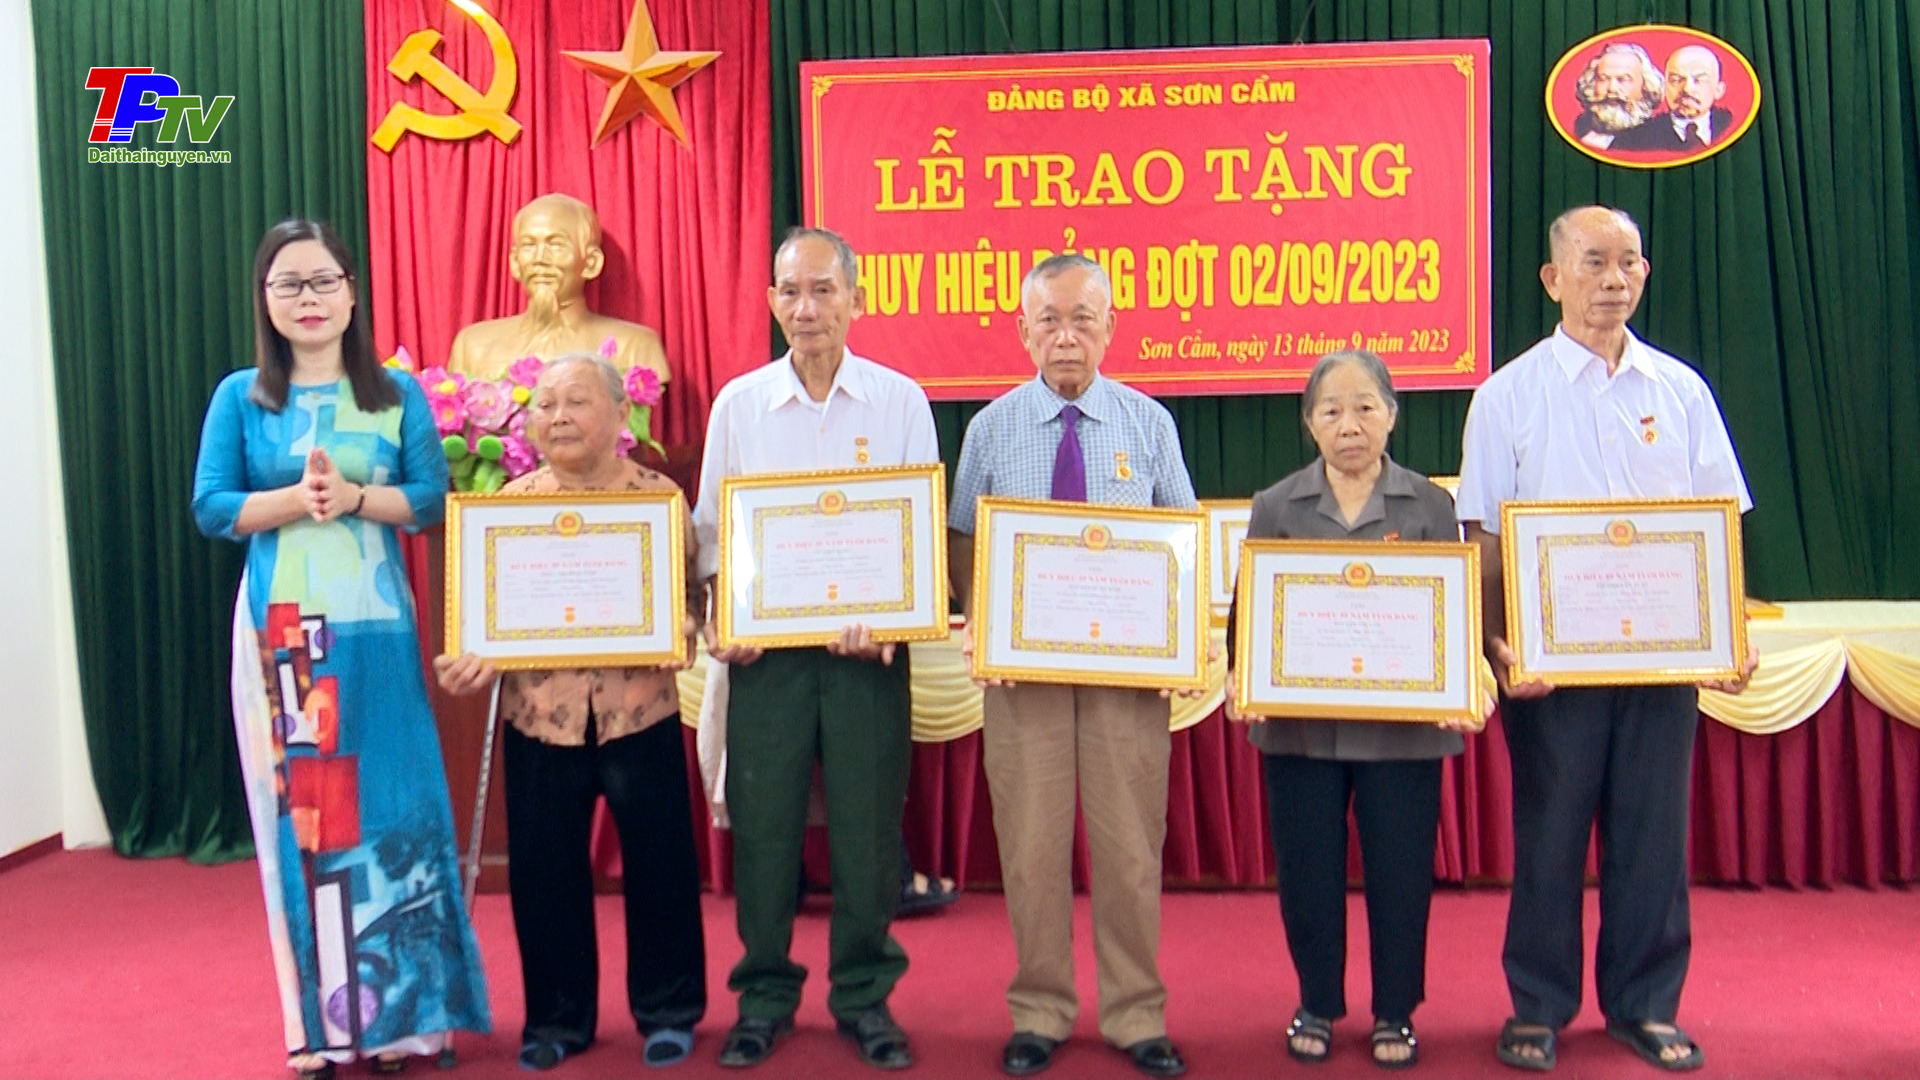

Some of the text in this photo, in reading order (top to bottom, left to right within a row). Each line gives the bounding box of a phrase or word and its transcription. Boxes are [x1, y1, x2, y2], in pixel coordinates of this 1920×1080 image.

[987, 74, 1295, 112] ĐẢNG BỘ XÃ SƠN CẨM
[873, 126, 1413, 216] LỄ TRAO TẶNG
[855, 253, 924, 315] HUY
[935, 237, 1021, 327] HIỆU
[1146, 238, 1219, 322] ĐỢT
[1229, 238, 1441, 307] 02/09/2023
[1138, 337, 1173, 360] Sơn
[1226, 334, 1269, 362] ngày
[1273, 333, 1293, 356] 13
[1351, 331, 1363, 350] 9
[1365, 331, 1404, 354] năm
[1408, 328, 1450, 353] 2023
